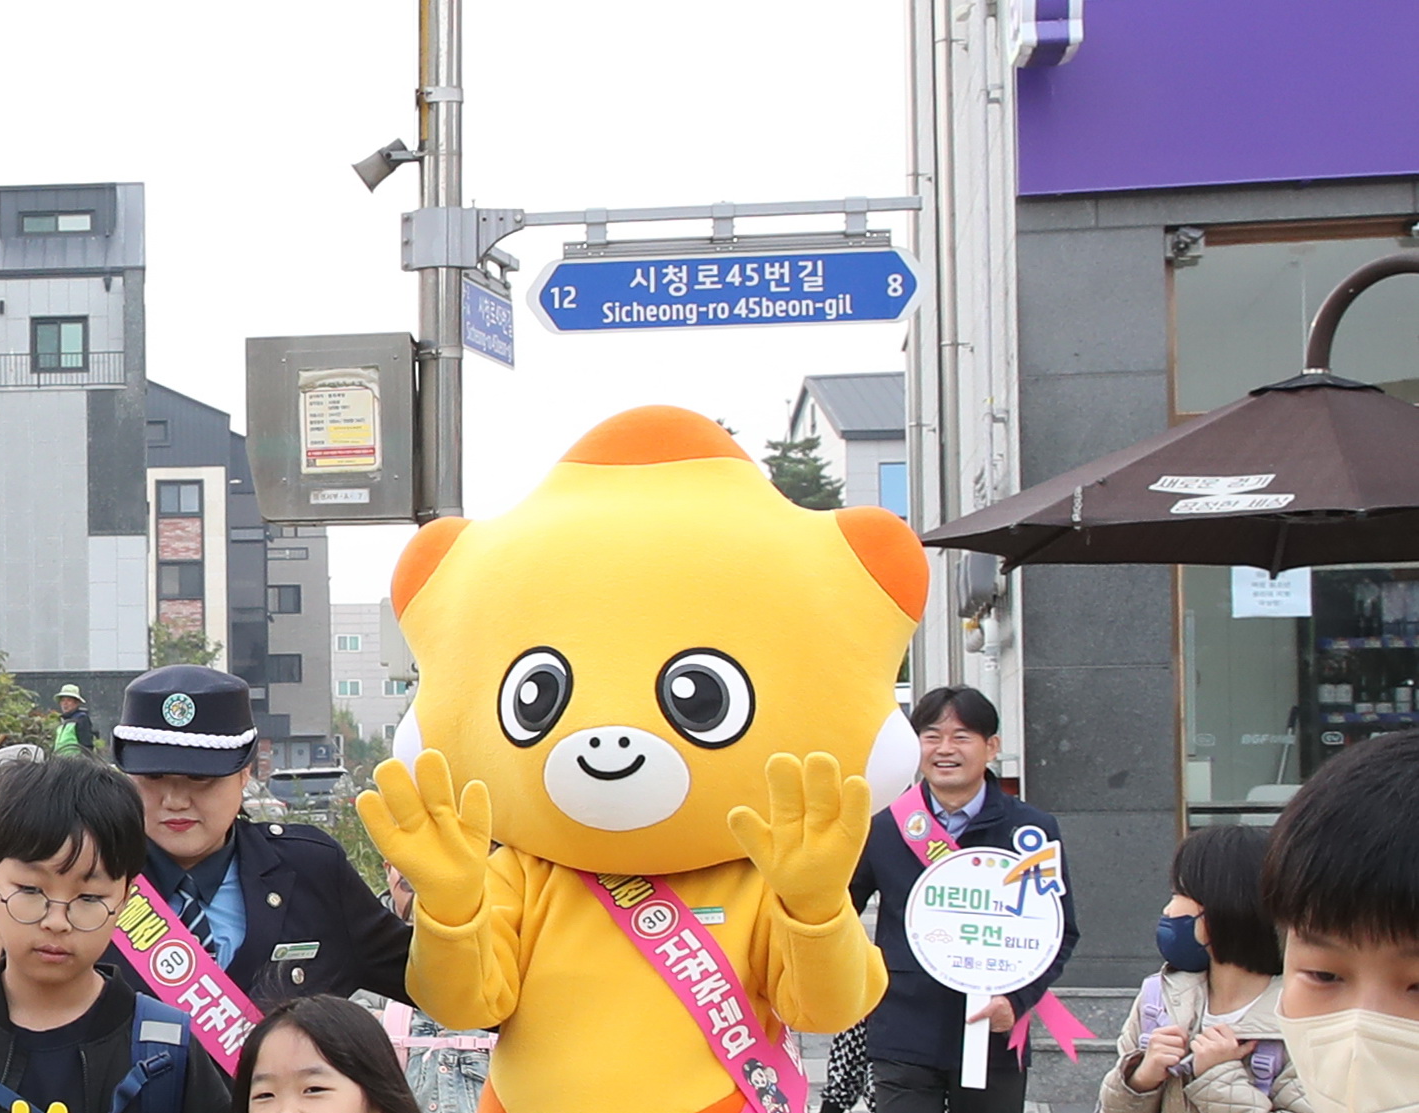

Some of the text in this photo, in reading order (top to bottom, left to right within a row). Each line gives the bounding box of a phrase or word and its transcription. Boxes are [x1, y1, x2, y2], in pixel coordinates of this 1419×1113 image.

[629, 260, 824, 298] 시청로45번길
[886, 273, 904, 297] 8
[550, 286, 578, 309] 12
[602, 294, 853, 325] Sicheong-ro 45beon-gil
[924, 885, 1003, 912] 어린이가
[642, 909, 668, 930] 30
[959, 923, 1040, 950] 우선입니다
[160, 951, 185, 975] 30
[654, 928, 758, 1061] 지켜주세요
